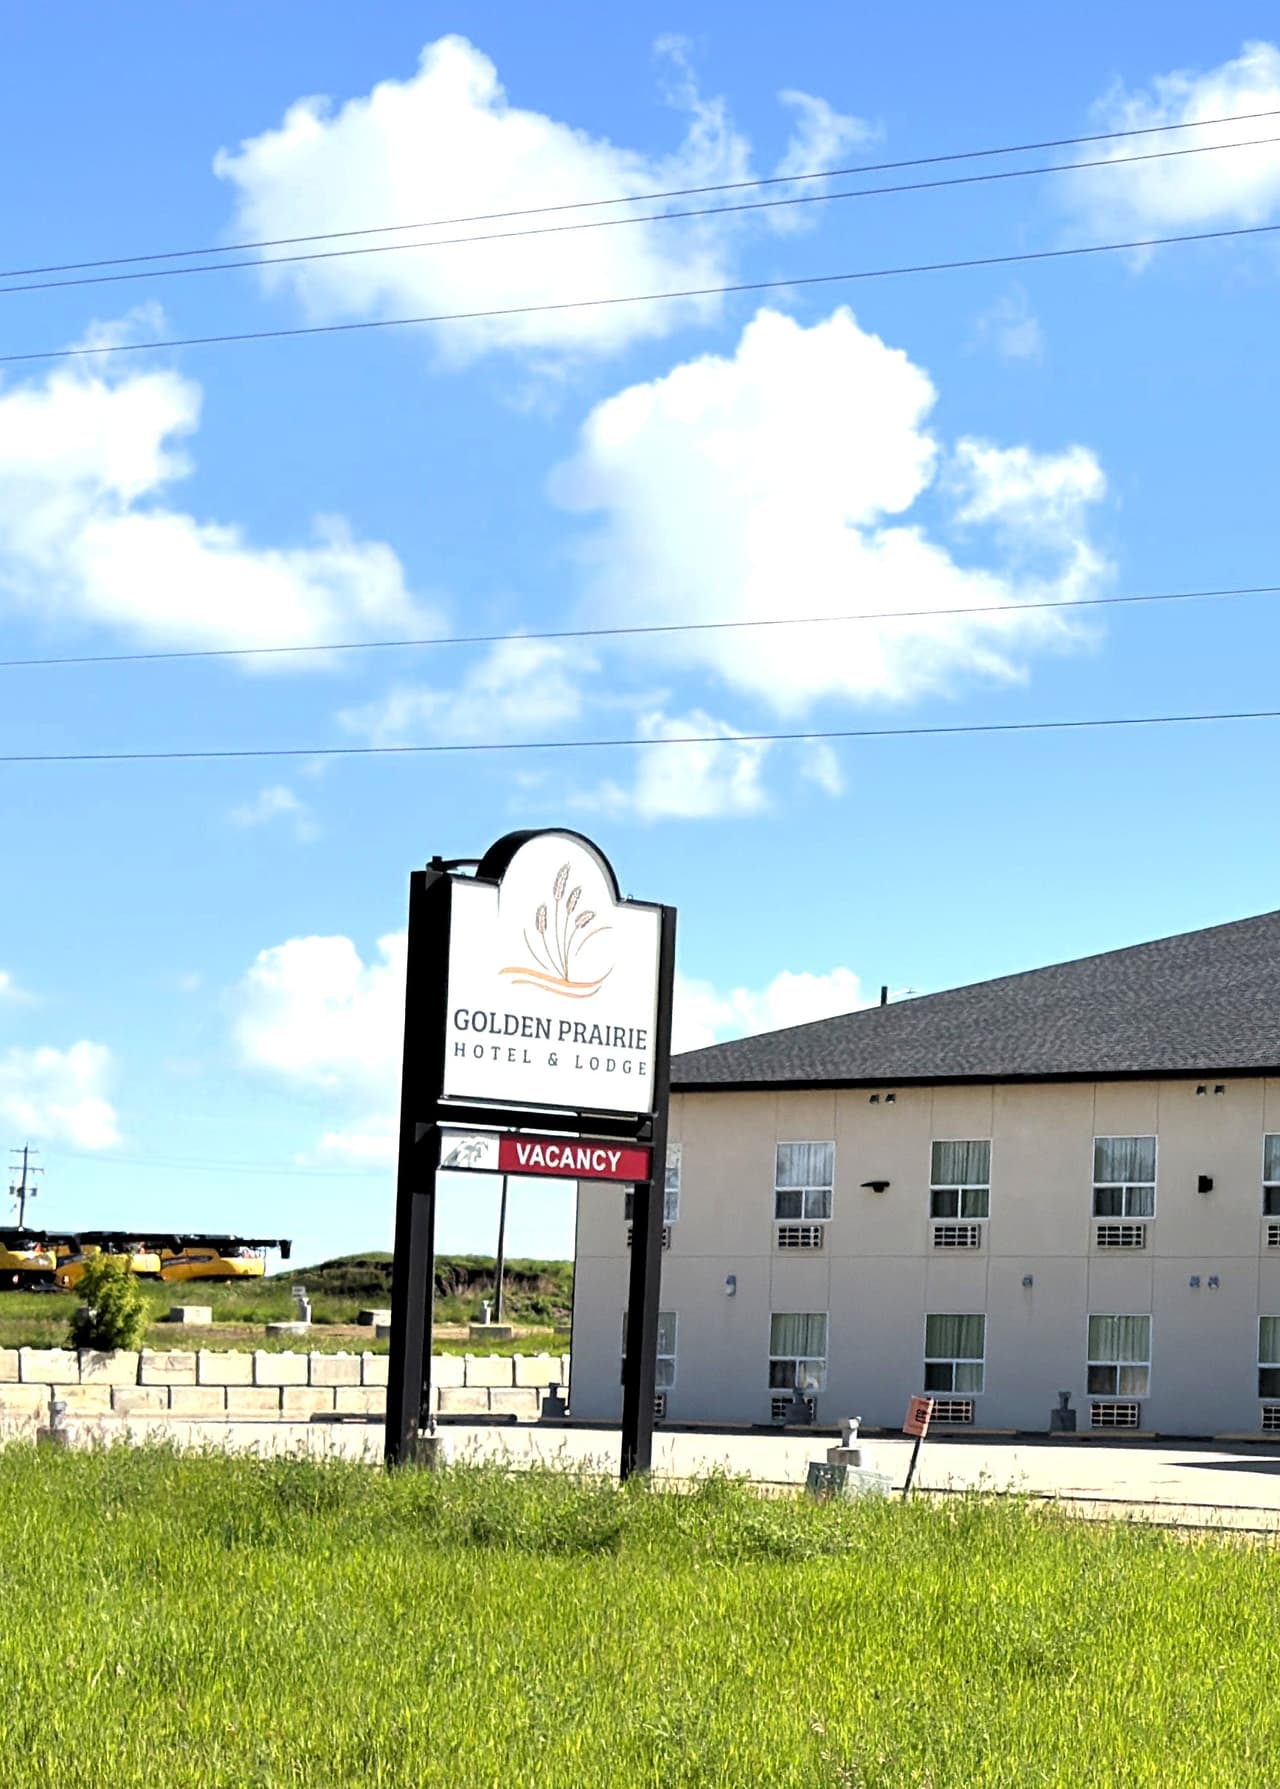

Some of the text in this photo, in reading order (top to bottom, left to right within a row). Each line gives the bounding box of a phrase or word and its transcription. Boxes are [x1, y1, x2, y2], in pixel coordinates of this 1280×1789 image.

[453, 1008, 648, 1051] GOLDEN PRAIRIE
[453, 1041, 647, 1076] HOTEL & LODGE
[515, 1143, 622, 1173] VACANCY
